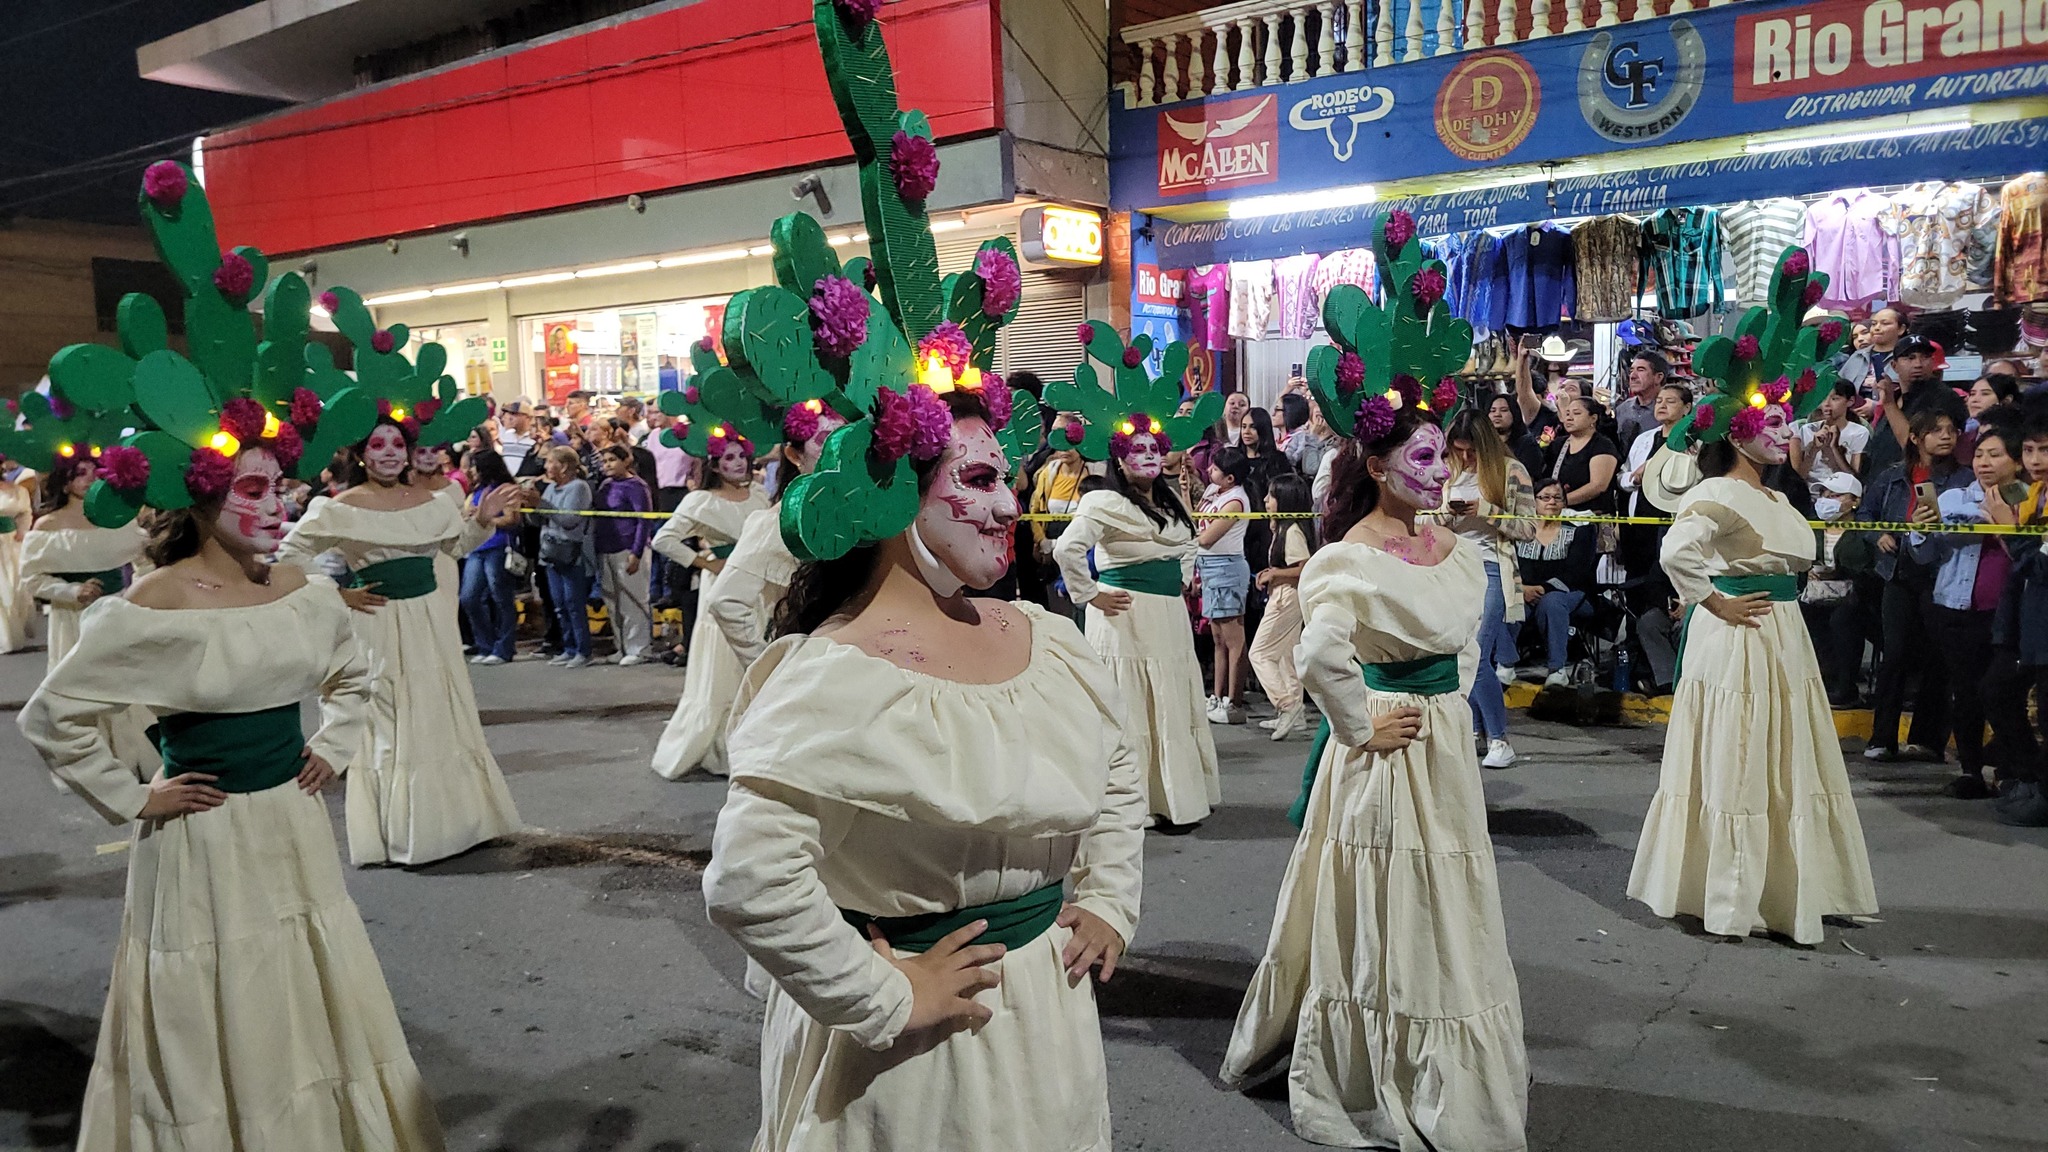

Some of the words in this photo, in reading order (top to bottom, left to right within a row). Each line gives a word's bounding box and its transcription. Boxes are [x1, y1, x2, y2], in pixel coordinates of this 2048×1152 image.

[1753, 14, 1852, 85] Rio
[1604, 41, 1664, 108] GF
[1311, 85, 1372, 110] RODEO
[1320, 104, 1356, 117] CARTE
[1471, 75, 1503, 111] D
[1785, 83, 1916, 120] DISTRIBUIDOR
[1599, 105, 1684, 138] WESTERN
[1467, 148, 1507, 161] CLIENTE
[1164, 221, 1232, 247] CONTAMOS
[1233, 215, 1265, 239] CON
[1271, 215, 1292, 233] LAS
[1297, 204, 1356, 228] MEJORES
[1423, 195, 1440, 212] EN
[1416, 213, 1449, 234] PARA
[1464, 206, 1497, 228] TODA
[1571, 192, 1592, 215] LA
[1601, 184, 1667, 212] FAMILIA
[1139, 270, 1156, 296] Rio
